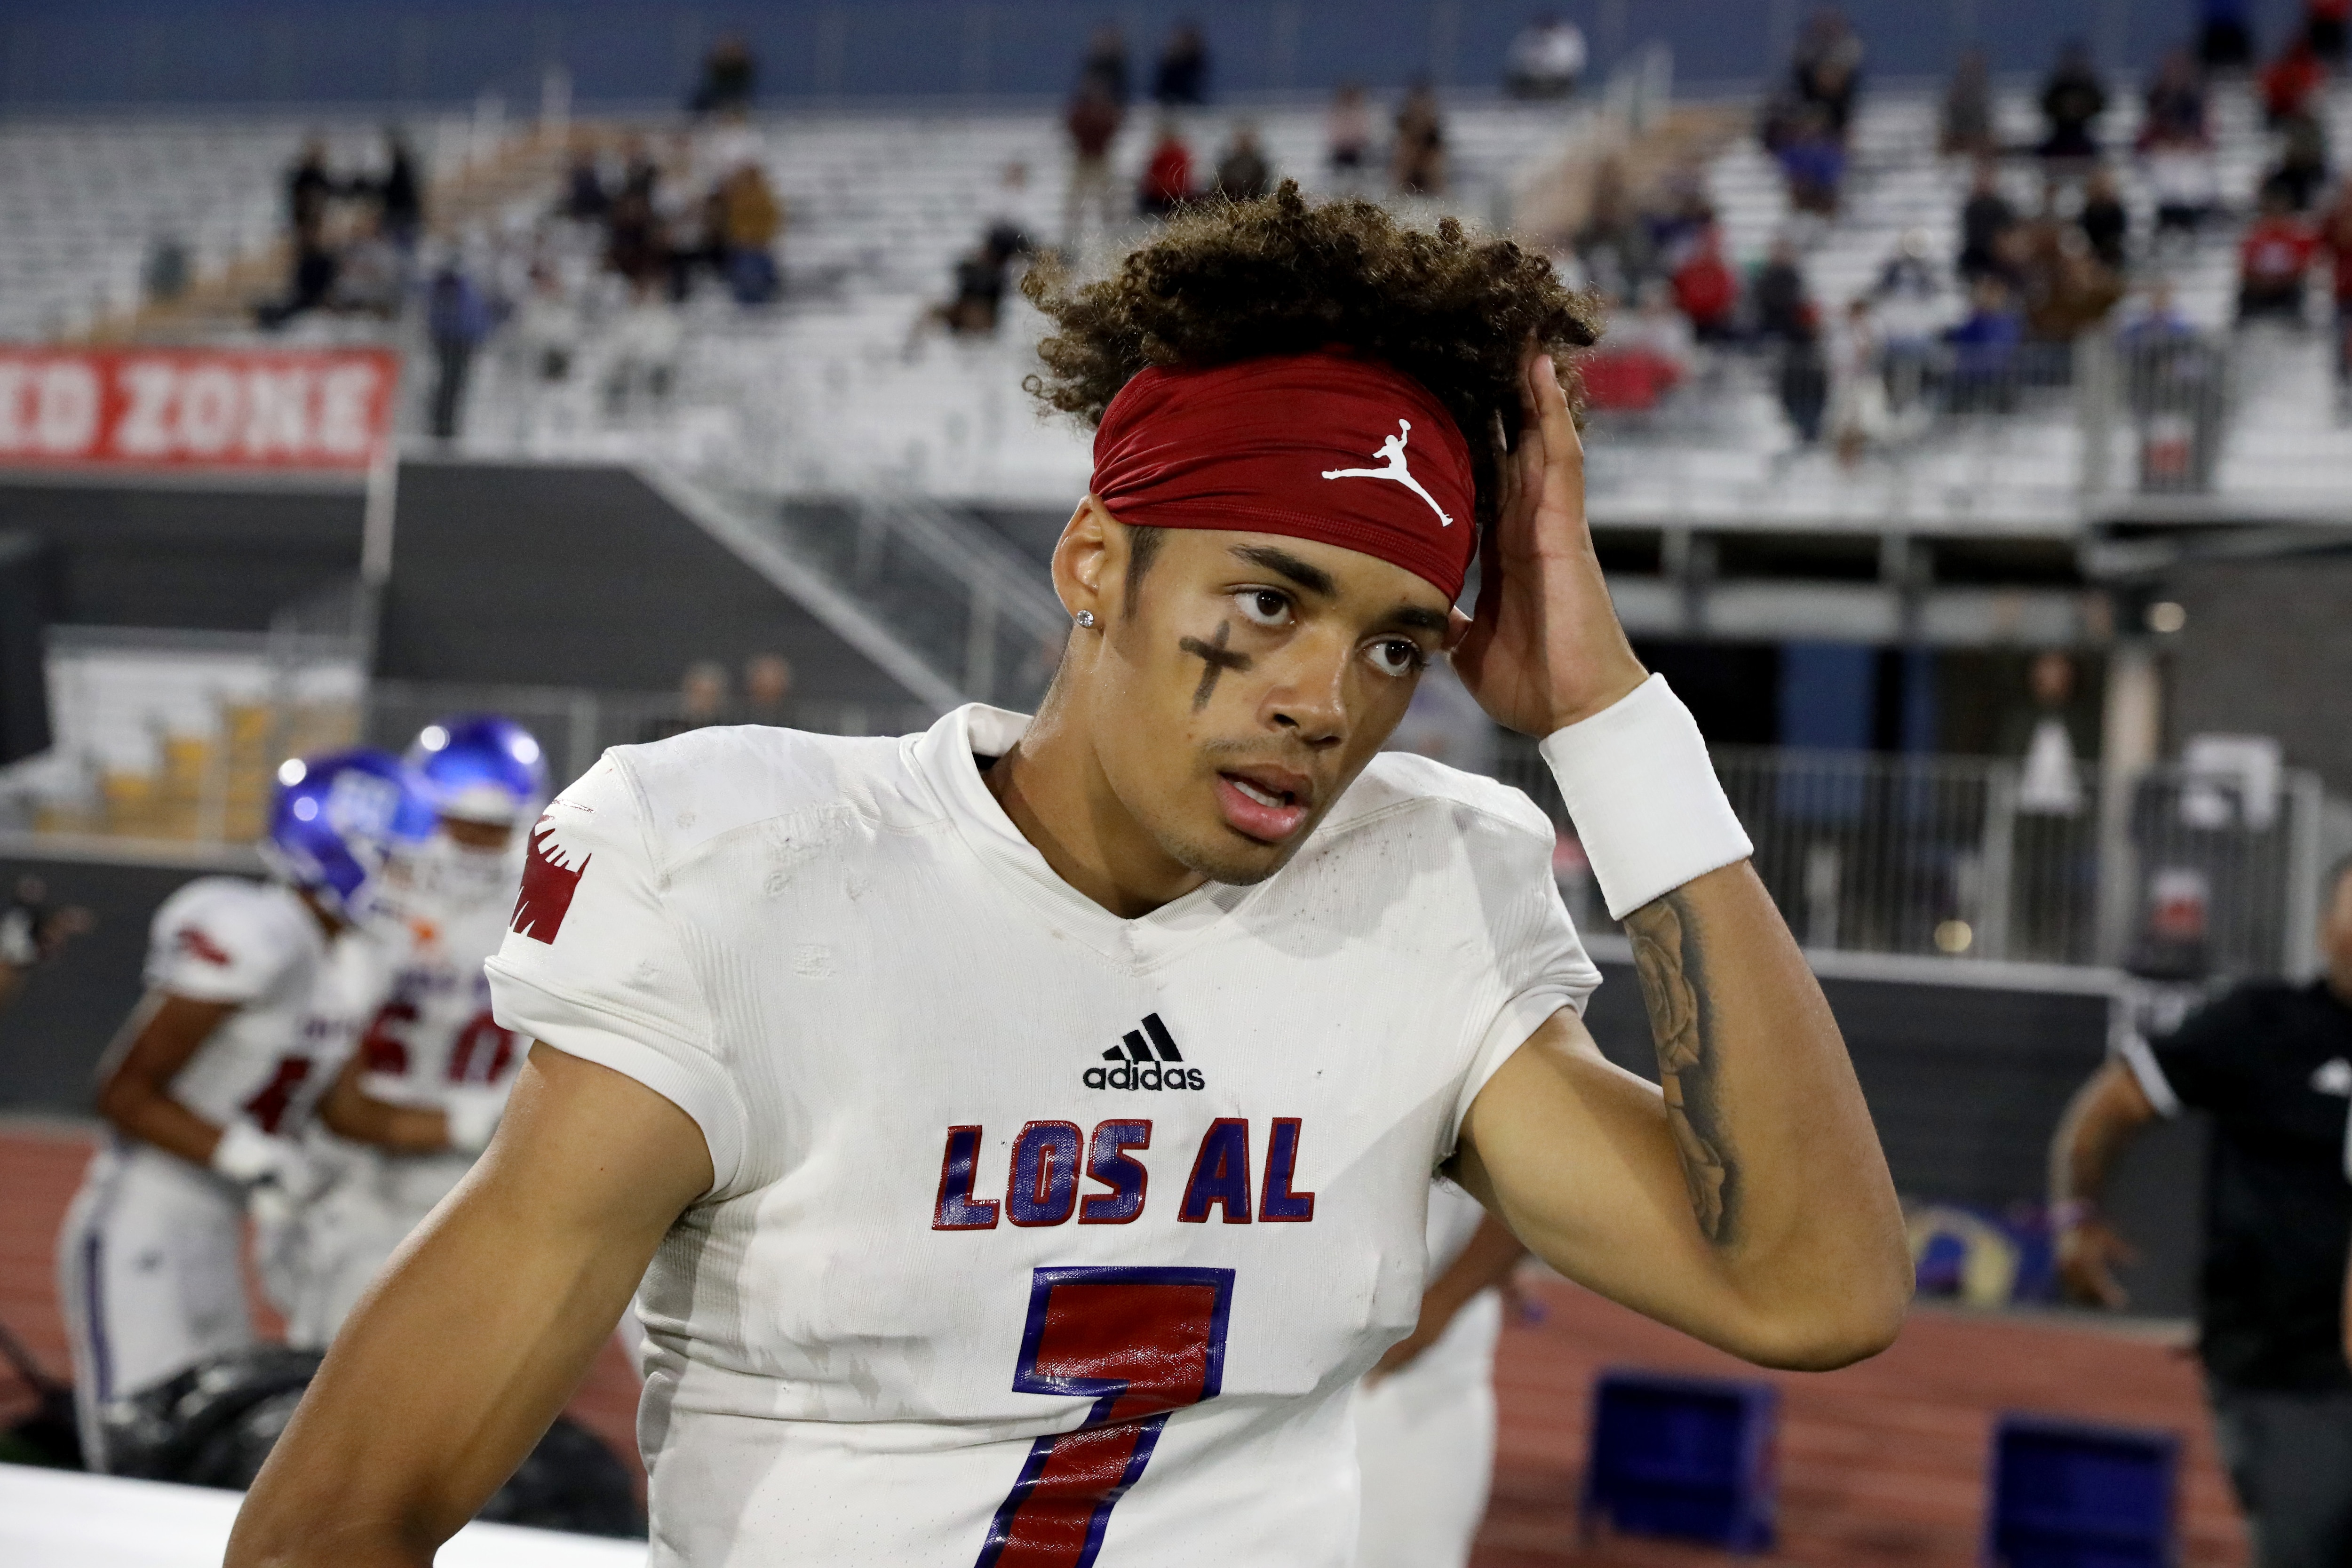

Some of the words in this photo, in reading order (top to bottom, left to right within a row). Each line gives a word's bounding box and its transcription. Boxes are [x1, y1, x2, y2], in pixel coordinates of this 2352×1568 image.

[118, 361, 374, 454] ZONE
[1083, 1059, 1205, 1091] adidas
[932, 1119, 1153, 1231] LOS
[1177, 1117, 1315, 1224] AL
[974, 1266, 1236, 1568] 7
